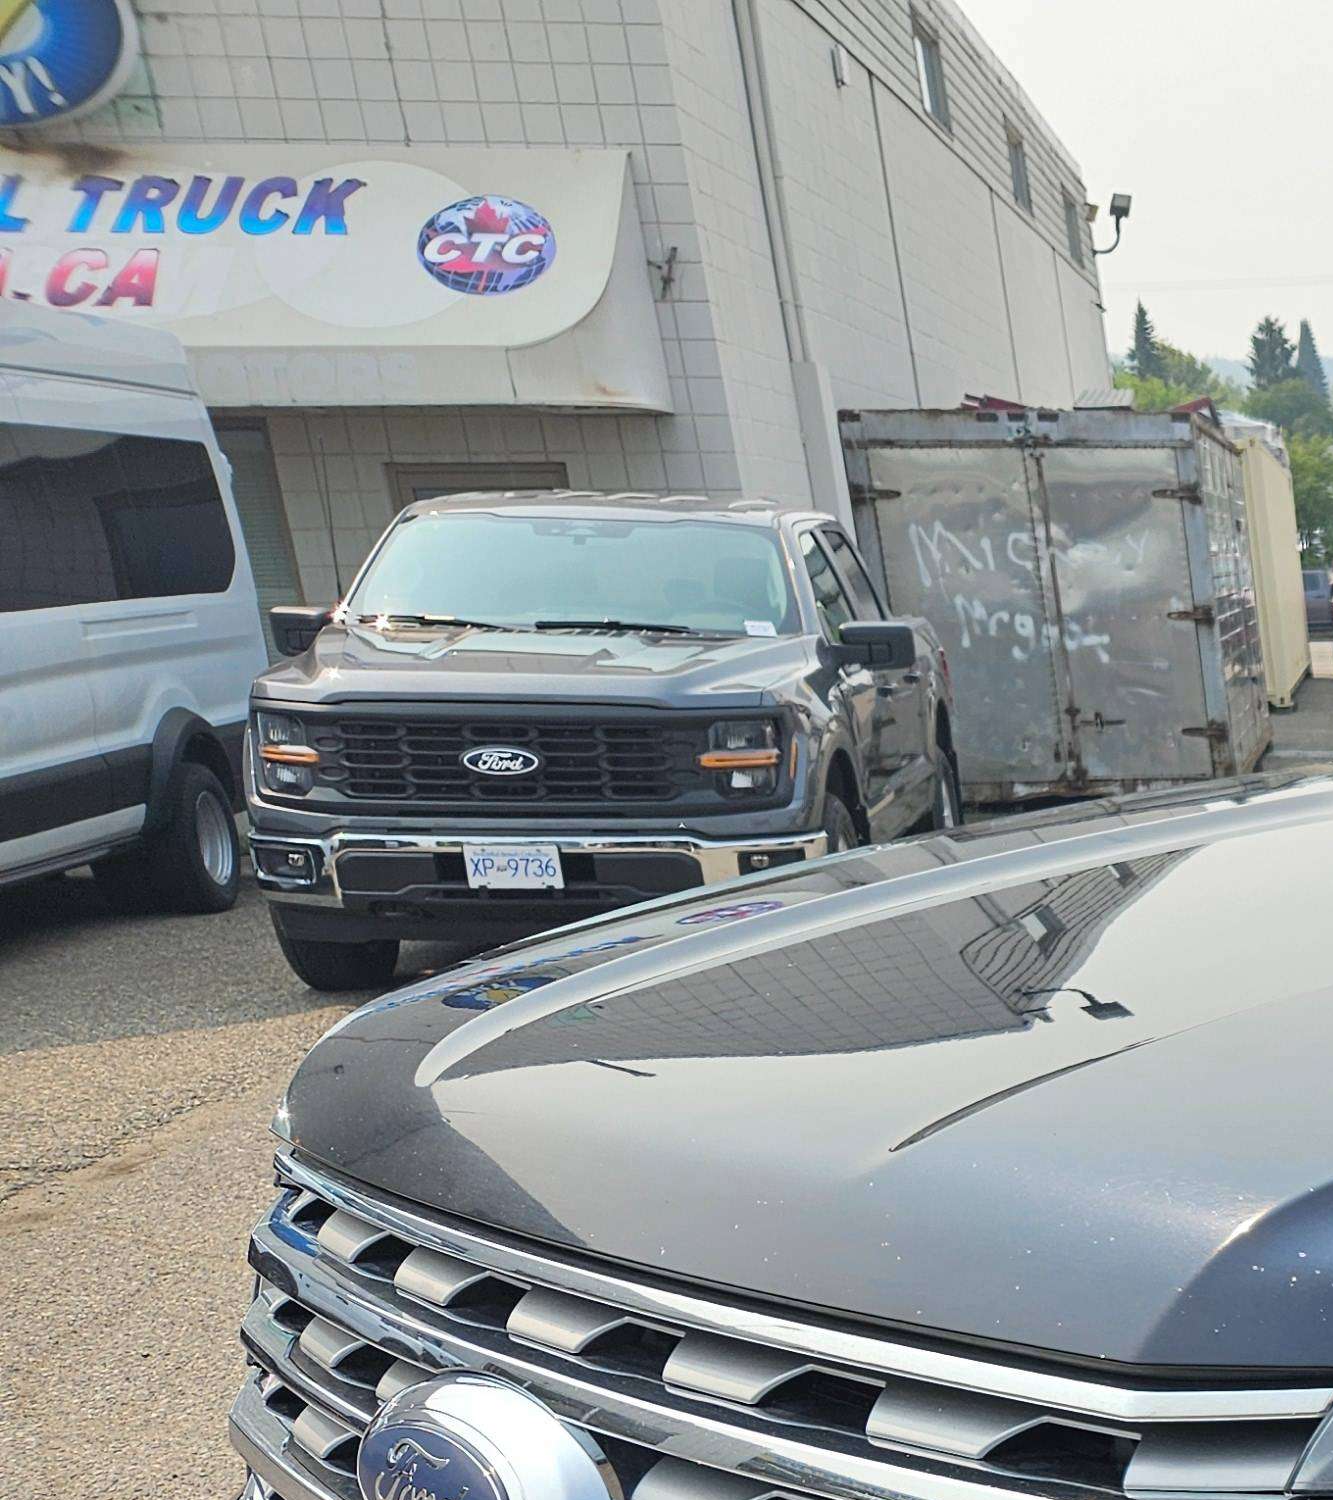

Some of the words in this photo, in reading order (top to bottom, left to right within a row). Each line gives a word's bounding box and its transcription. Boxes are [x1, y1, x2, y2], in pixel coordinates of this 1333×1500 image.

[66, 174, 367, 235] TRUCK
[423, 232, 546, 264] CTC
[478, 752, 524, 770] Ford
